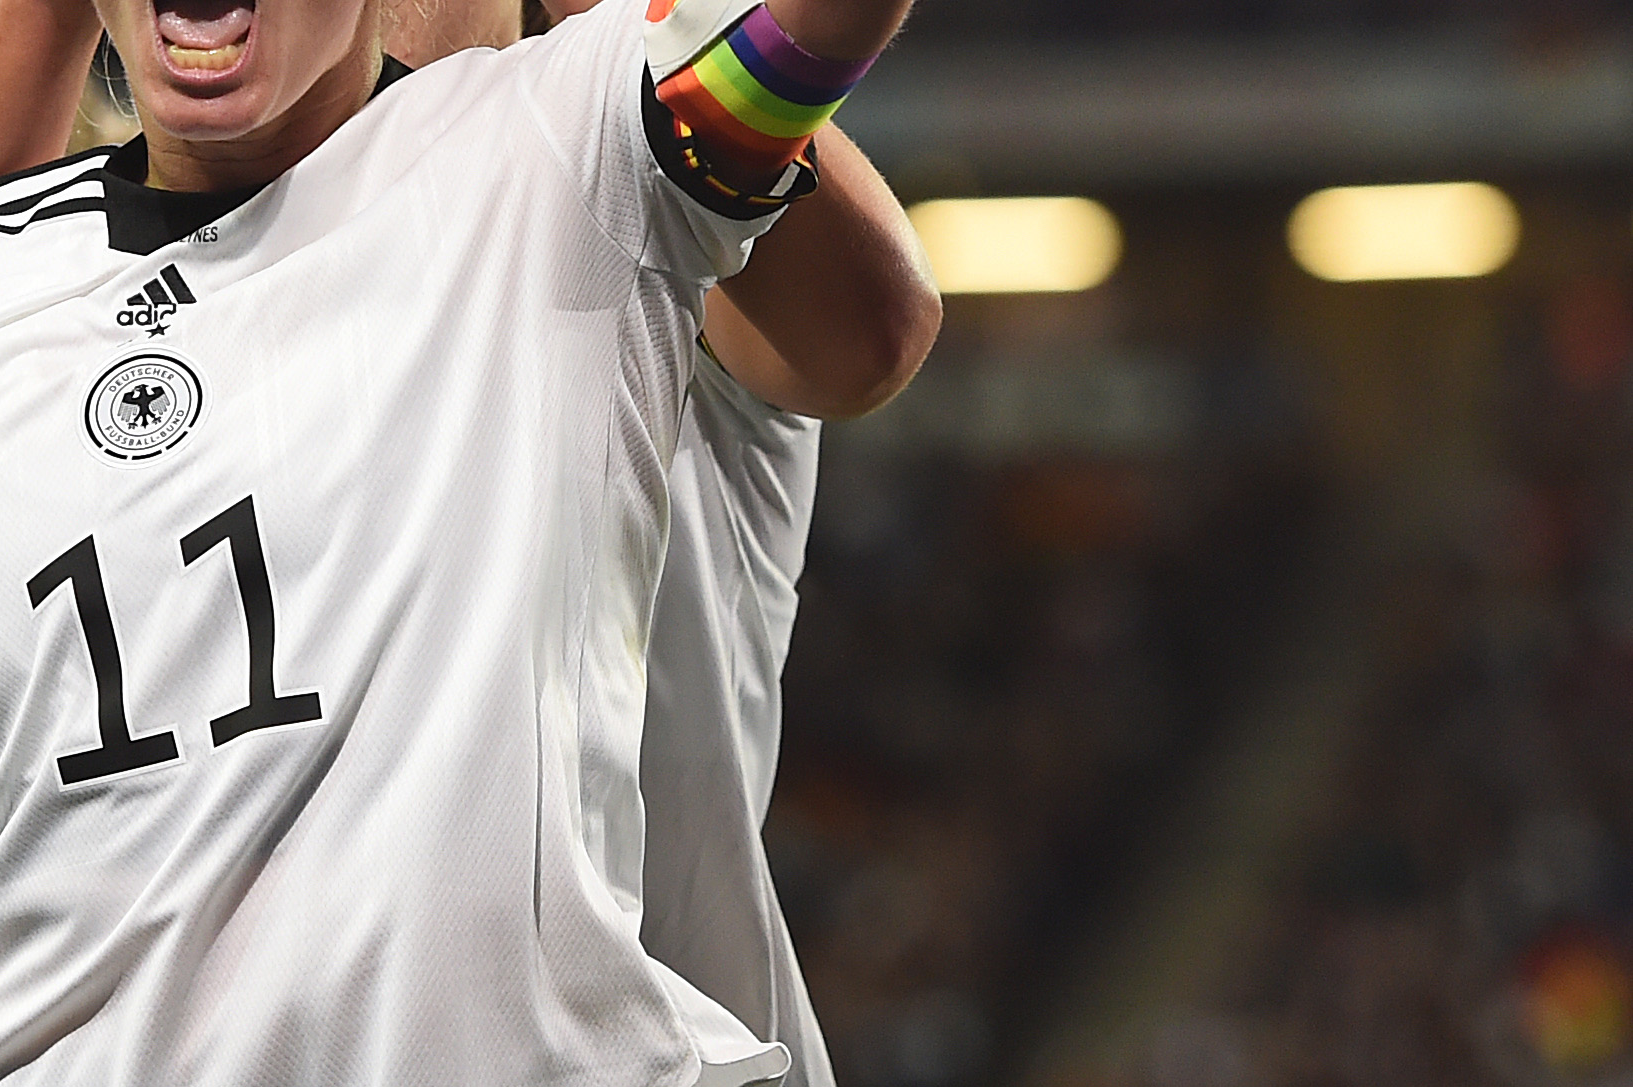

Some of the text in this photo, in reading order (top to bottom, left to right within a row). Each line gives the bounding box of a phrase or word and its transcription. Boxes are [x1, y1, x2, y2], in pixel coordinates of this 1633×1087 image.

[179, 226, 219, 244] NES
[108, 367, 175, 393] DEUTSCHER
[105, 409, 185, 446] FUSSBALL-BUND
[26, 493, 323, 786] 11
